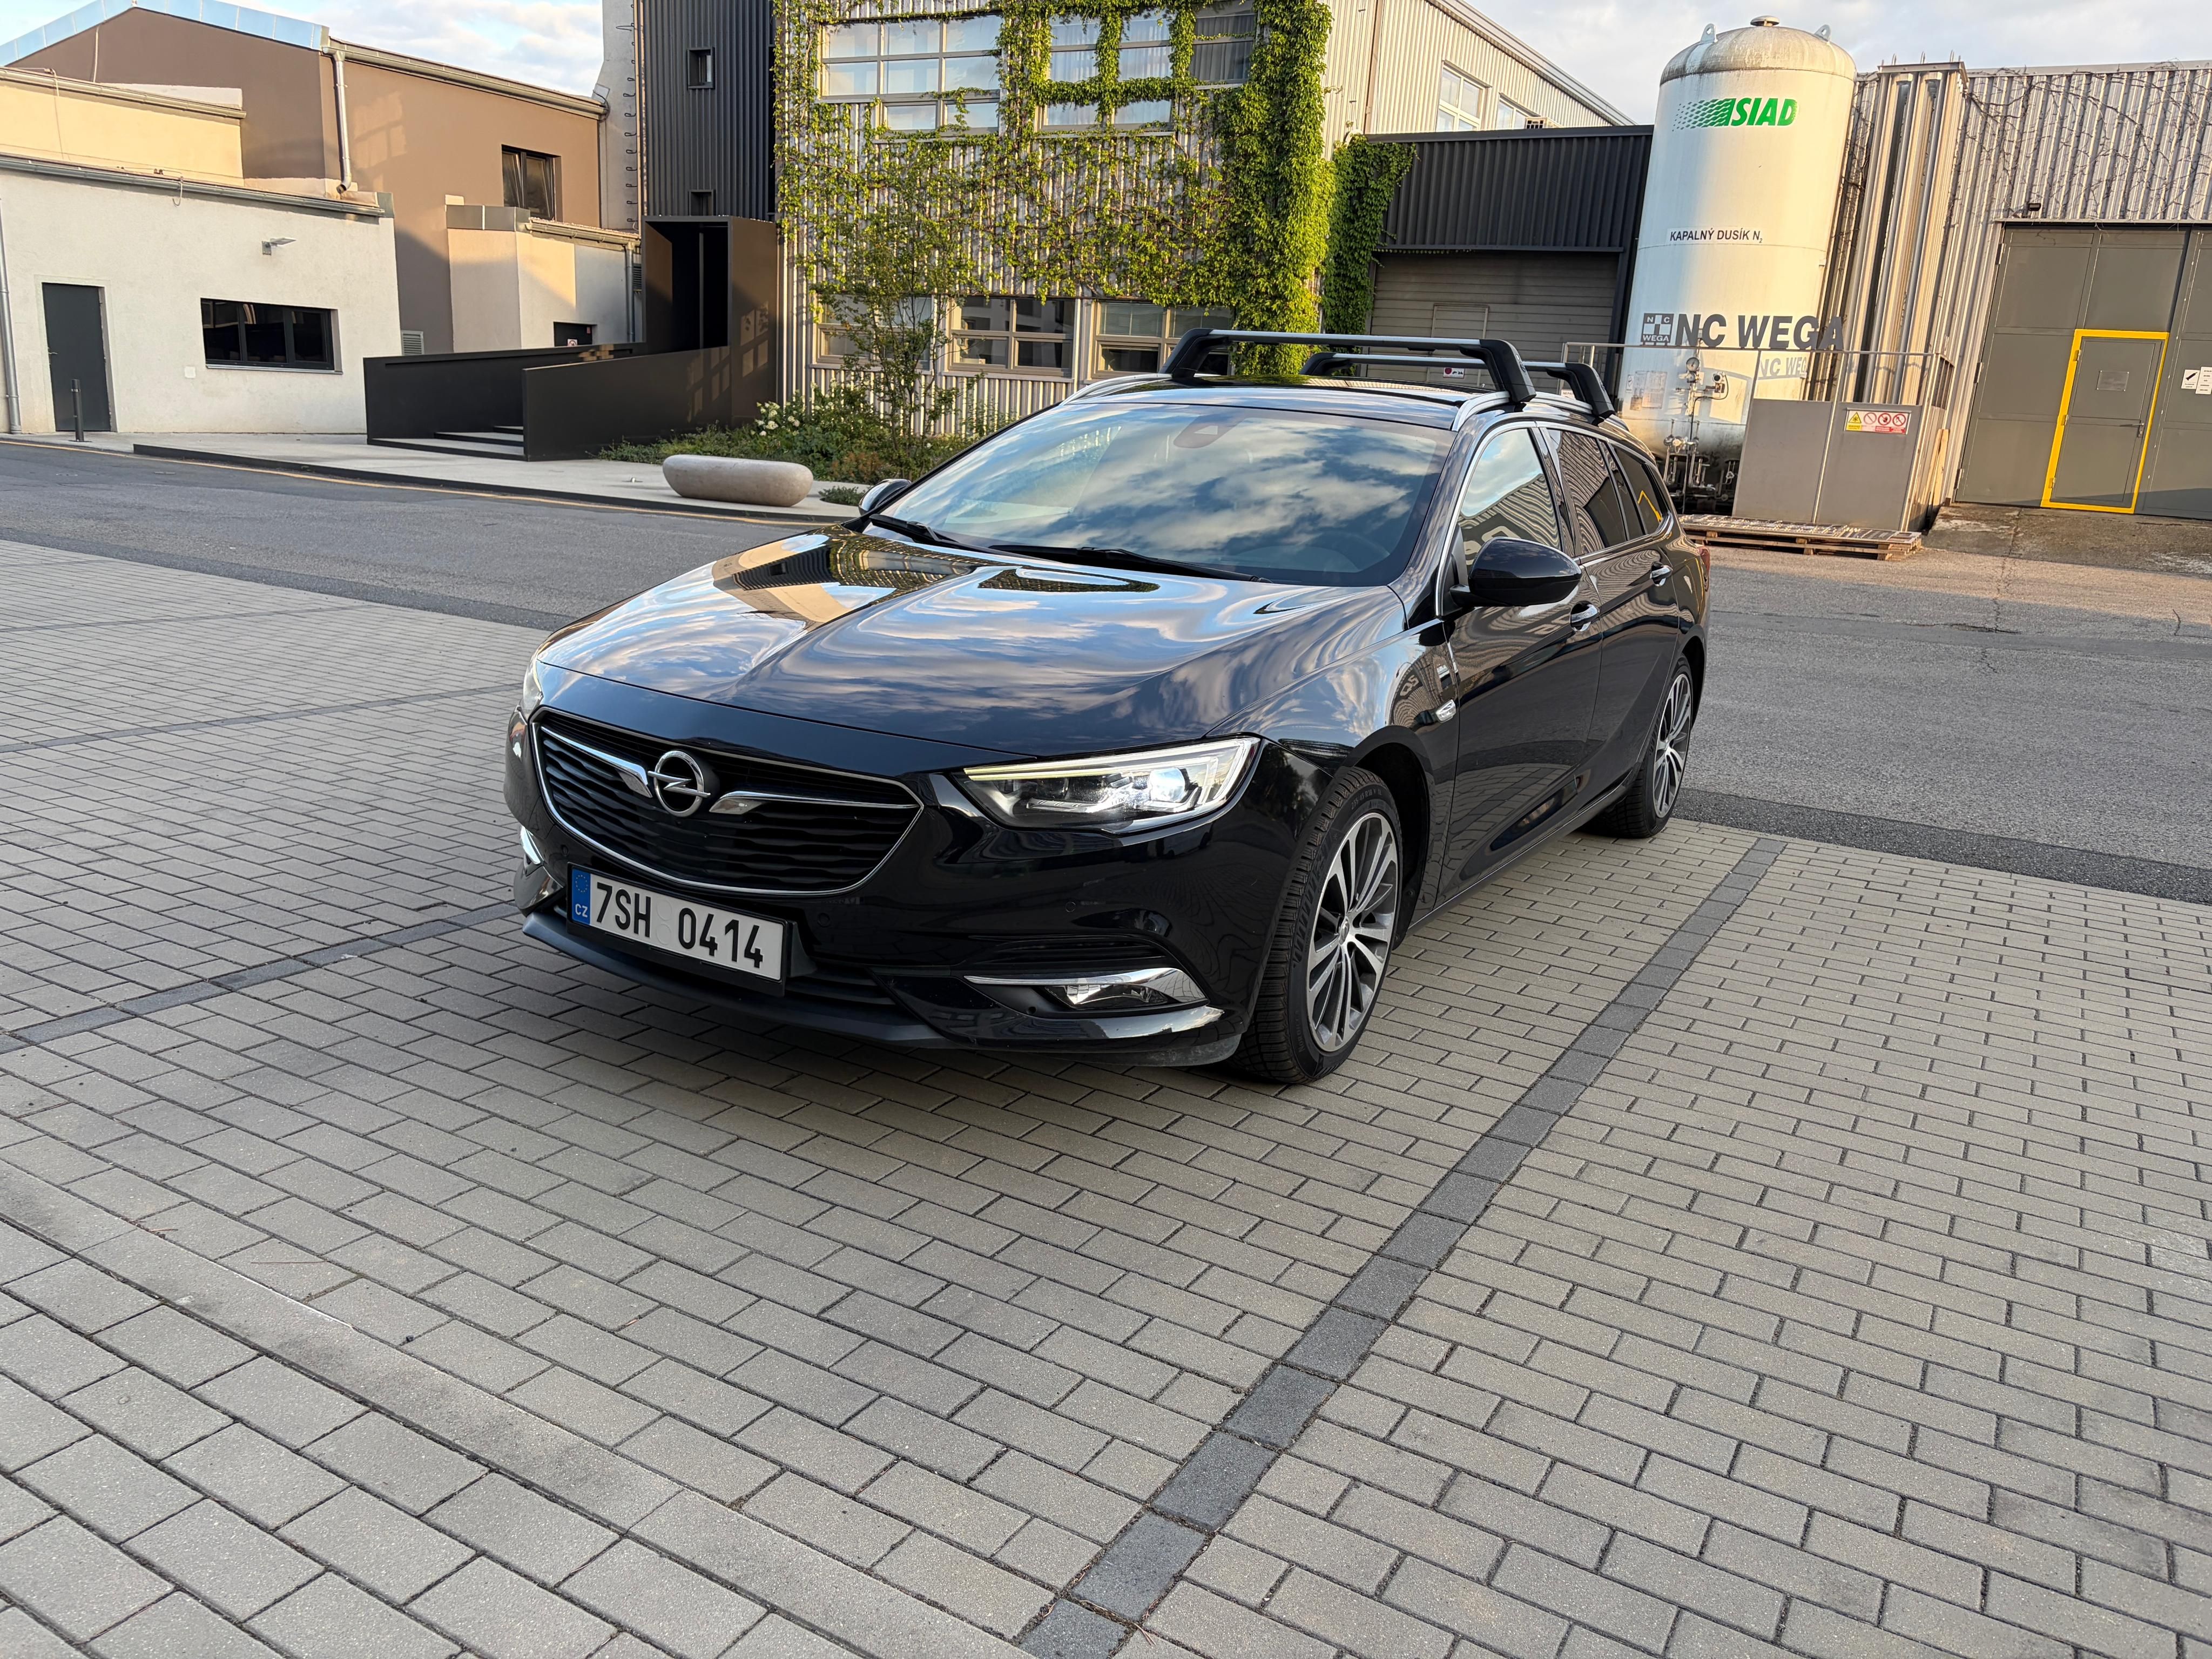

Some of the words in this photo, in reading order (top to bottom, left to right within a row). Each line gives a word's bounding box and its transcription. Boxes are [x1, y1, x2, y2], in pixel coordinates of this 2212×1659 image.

[1731, 98, 1798, 126] SIAD
[1670, 228, 1715, 241] KAPALNÝ
[1717, 228, 1750, 240] DUSÍK
[1675, 314, 1727, 347] NC
[1738, 315, 1844, 350] WEGA
[575, 903, 588, 918] CZ
[596, 882, 651, 938] 7SH
[678, 907, 763, 968] 0414
